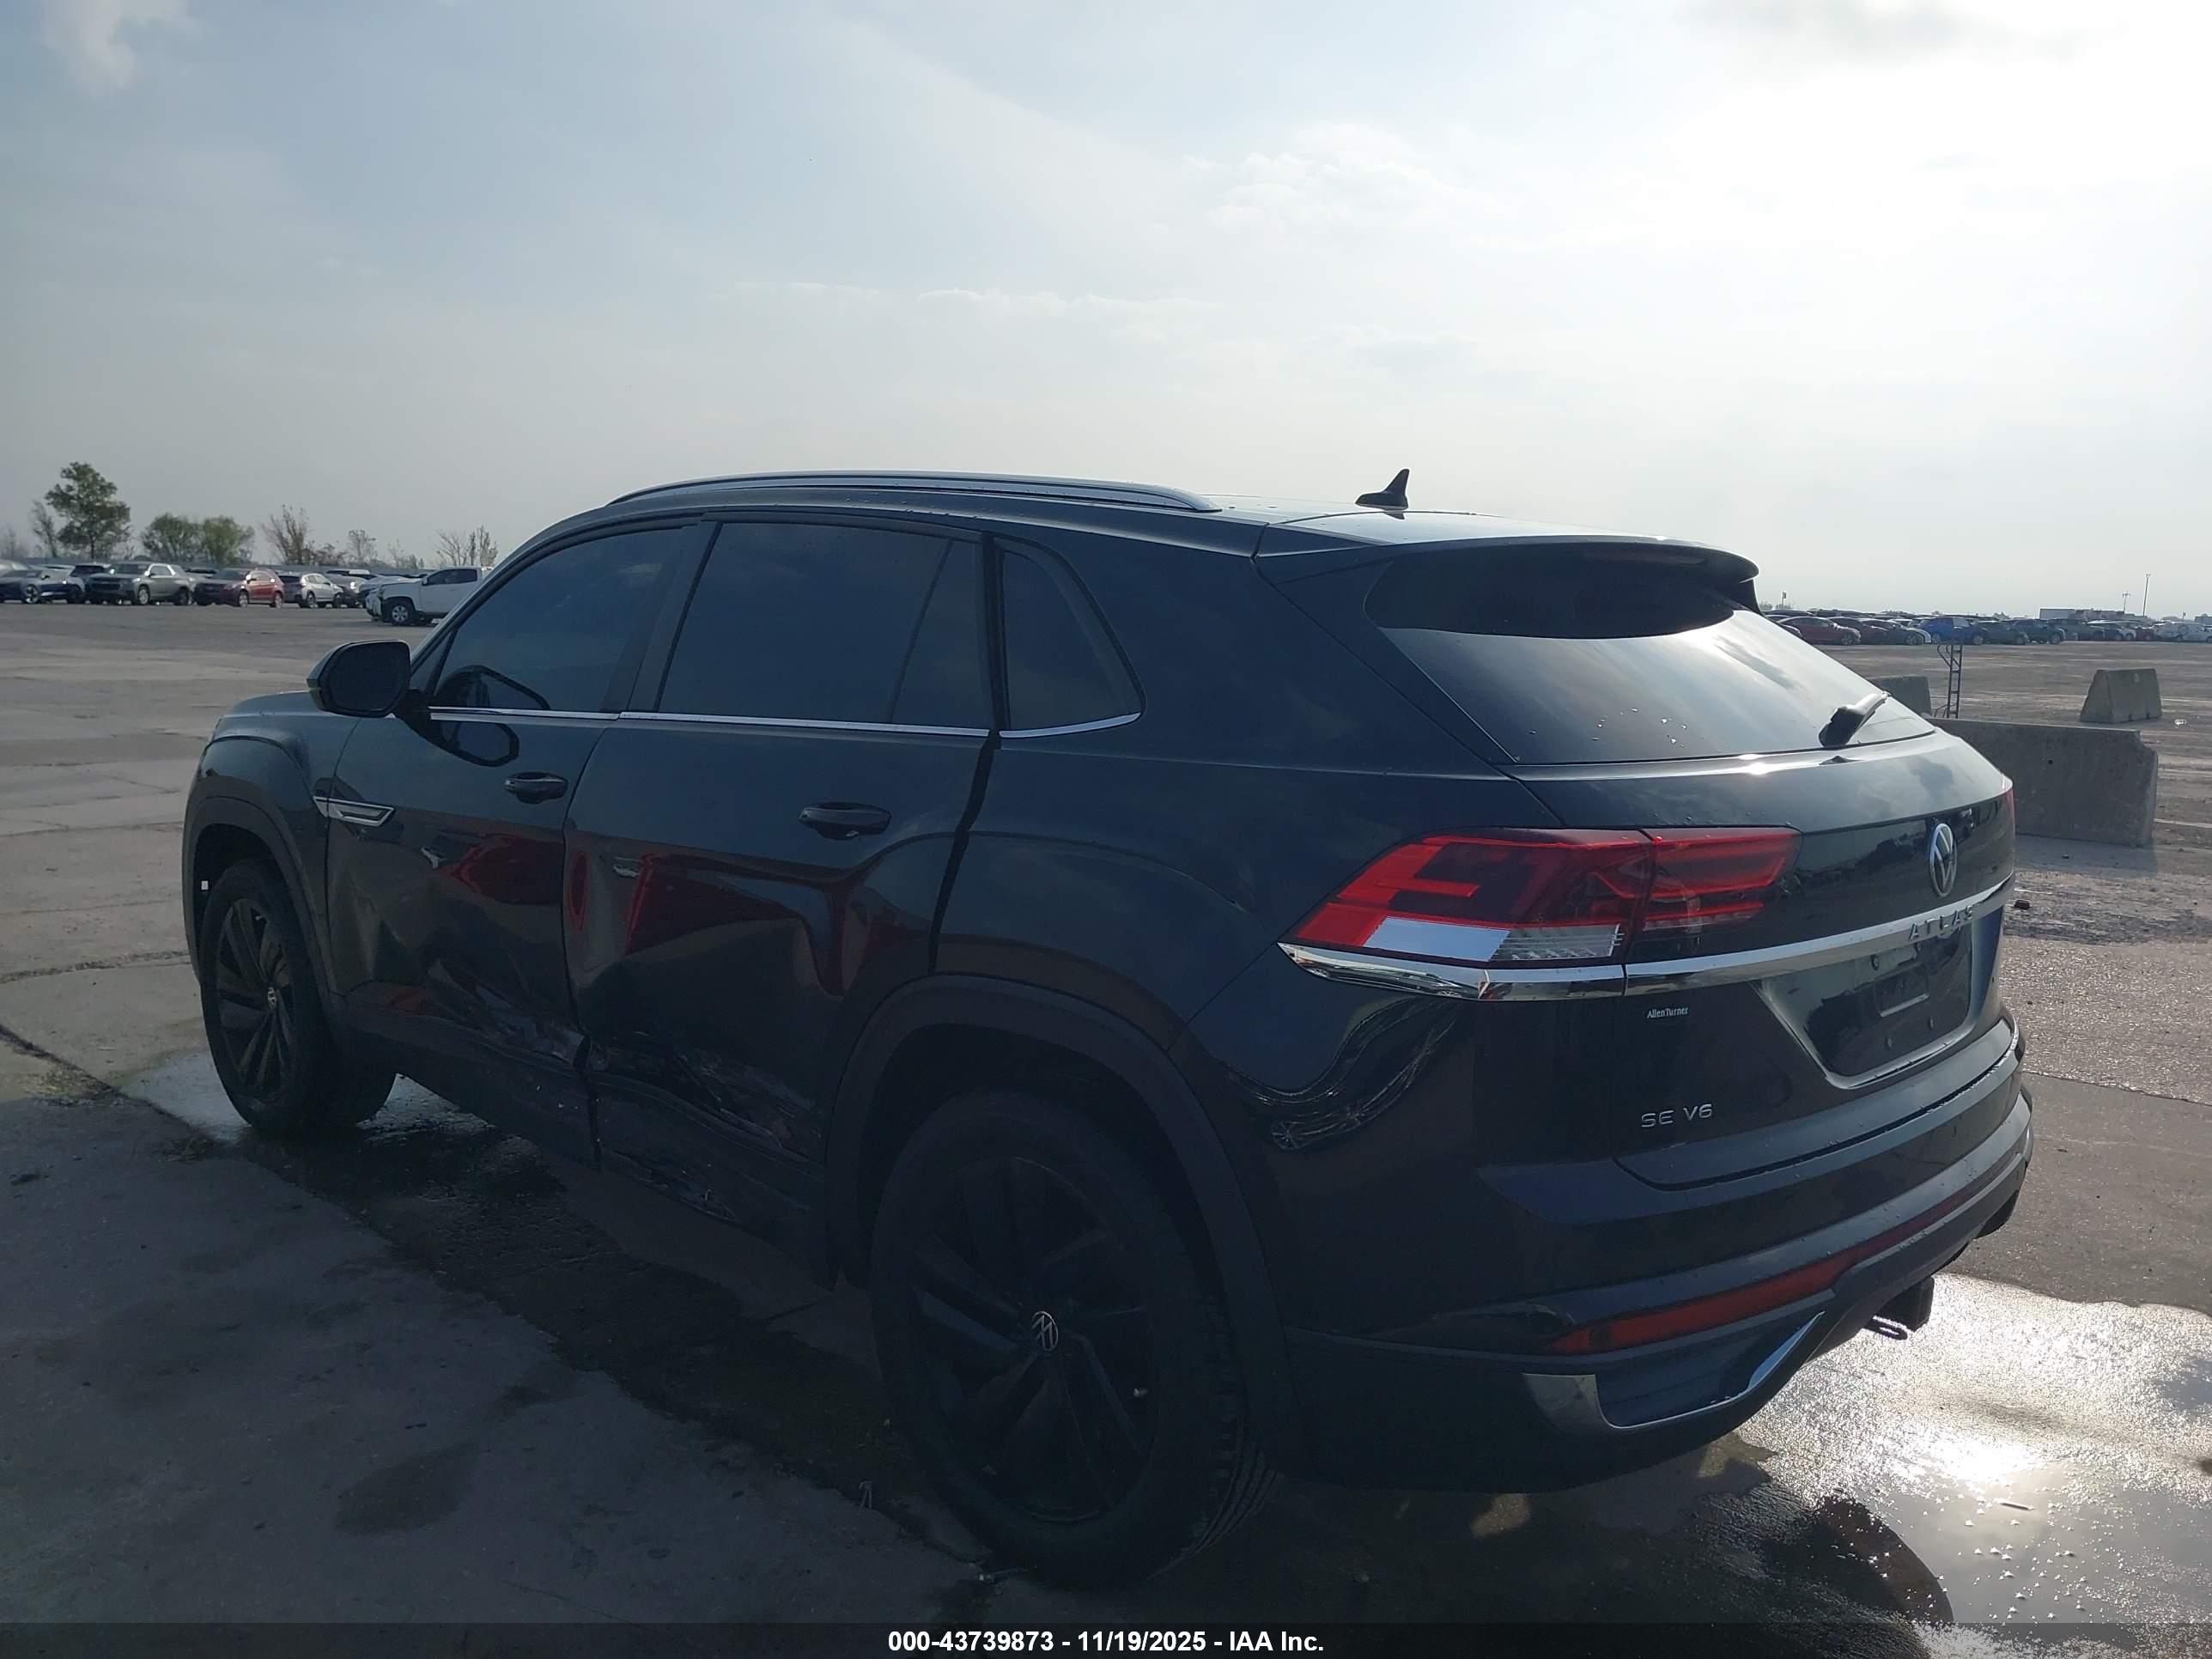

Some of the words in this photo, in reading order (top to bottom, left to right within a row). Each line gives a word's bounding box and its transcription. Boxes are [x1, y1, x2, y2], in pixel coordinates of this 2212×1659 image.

[1909, 906, 1973, 939] ATLAS
[1641, 1109, 1674, 1127] SE
[1683, 1103, 1712, 1121] V6
